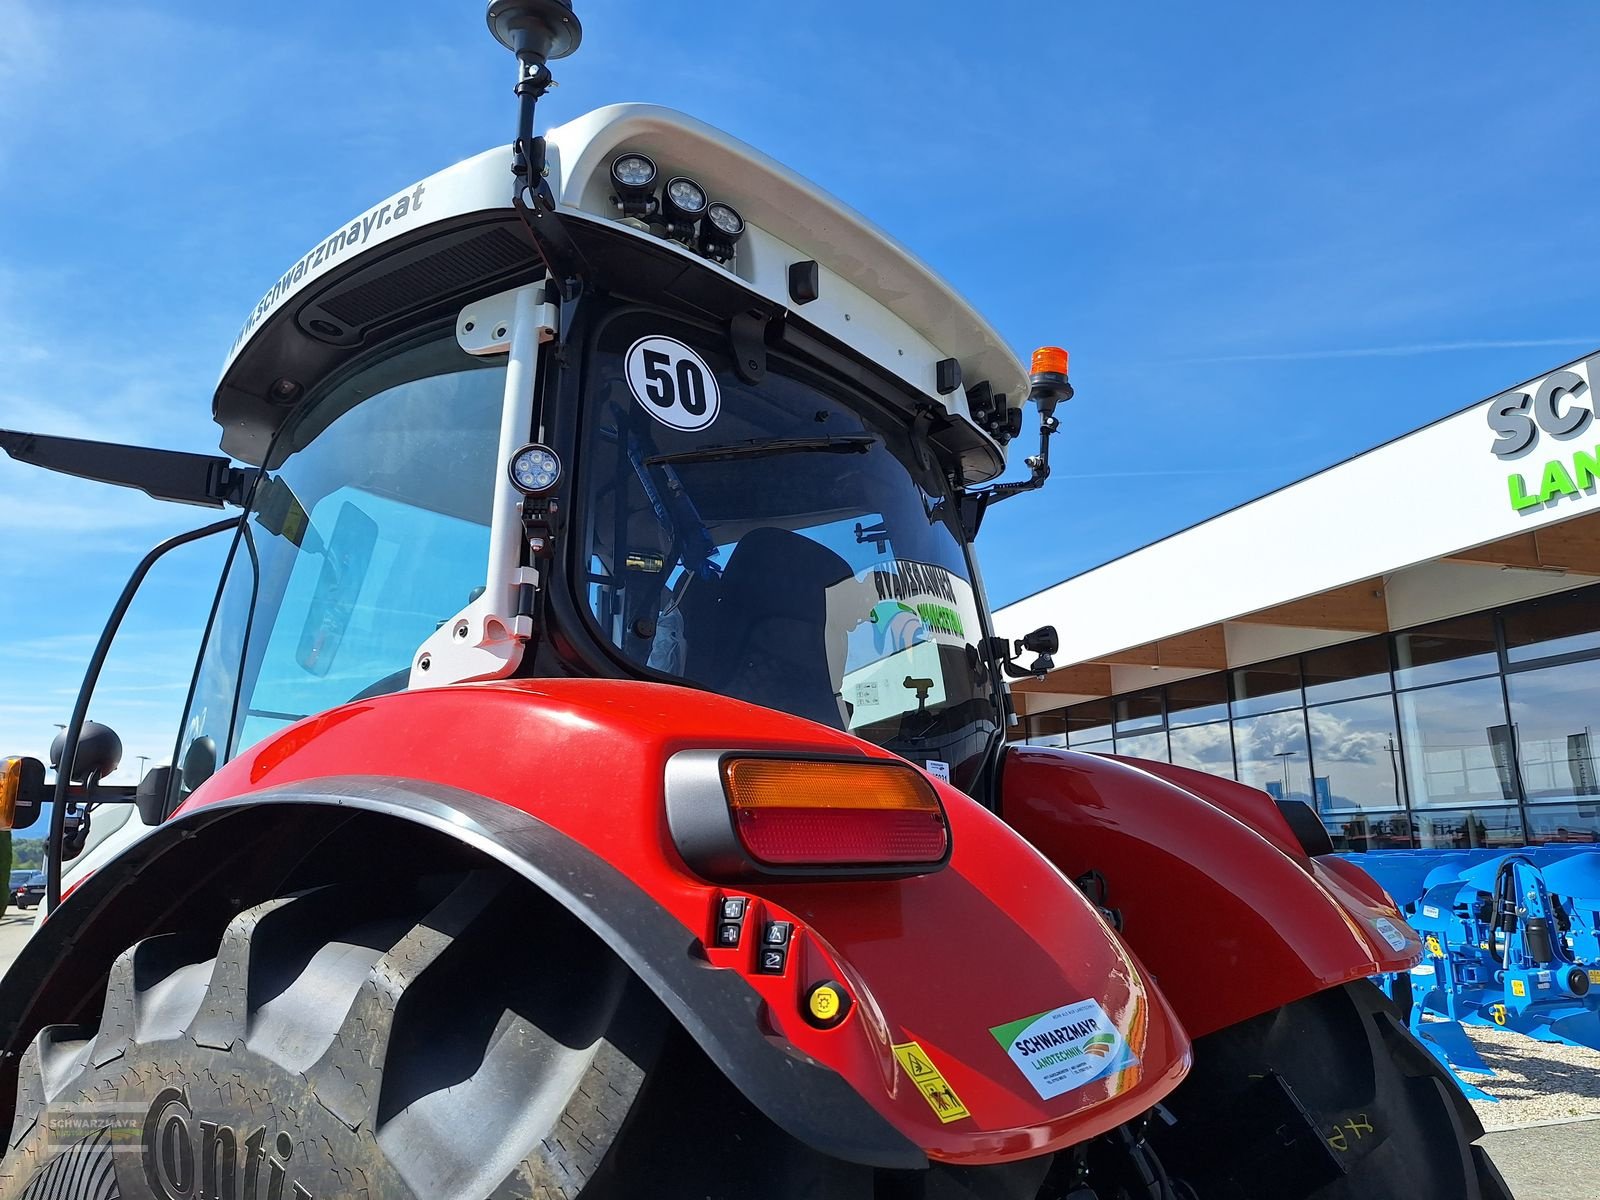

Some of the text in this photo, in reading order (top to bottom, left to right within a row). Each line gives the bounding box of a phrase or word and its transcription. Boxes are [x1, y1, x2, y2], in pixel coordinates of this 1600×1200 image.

[642, 348, 707, 416] 50
[1015, 1018, 1101, 1056] SCHWARZMAYR
[1031, 1046, 1084, 1070] LANDTECHNIK
